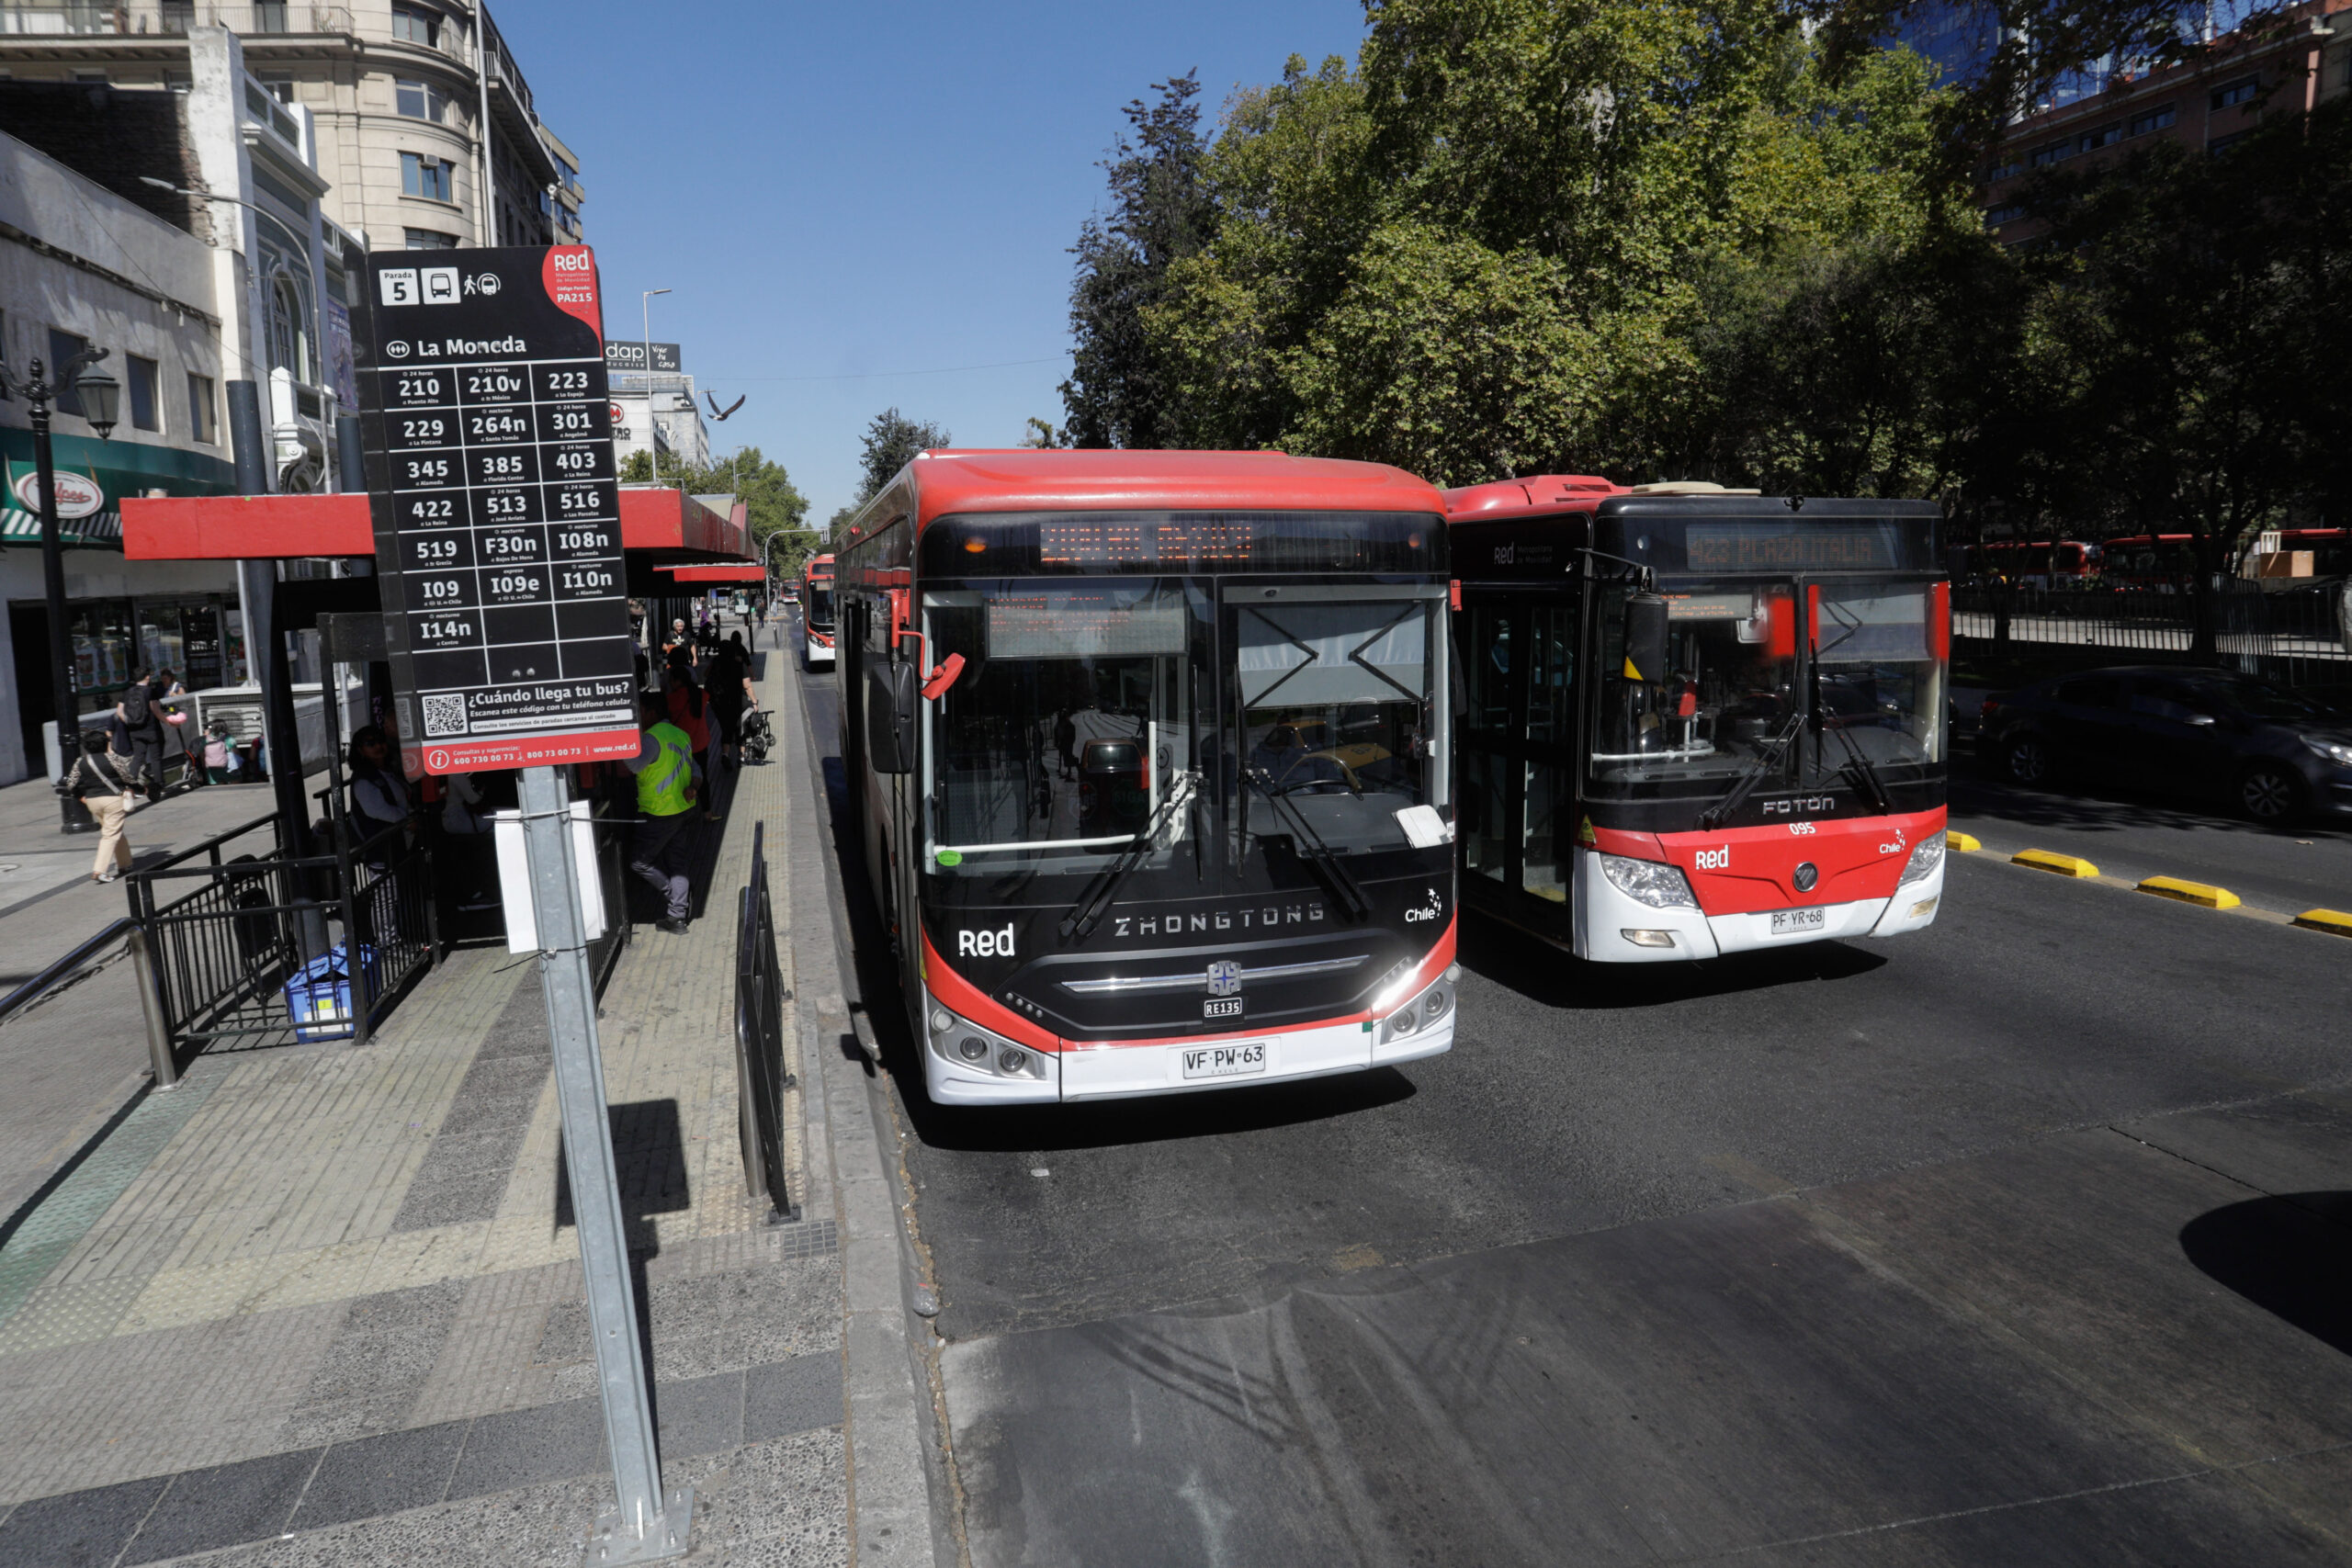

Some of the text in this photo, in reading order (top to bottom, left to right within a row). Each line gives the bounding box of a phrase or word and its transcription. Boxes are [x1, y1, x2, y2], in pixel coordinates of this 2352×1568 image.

[554, 250, 590, 271] Red
[393, 281, 406, 301] 5
[557, 292, 592, 303] PA215
[418, 335, 526, 356] La Moneda
[606, 343, 643, 361] dap
[657, 353, 666, 361] tu
[399, 378, 439, 396] 210
[469, 376, 521, 393] 210v
[548, 372, 588, 389] 223
[403, 420, 444, 437] 229
[471, 417, 526, 434] 264n
[552, 412, 593, 430] 301
[408, 460, 448, 478] 345
[482, 457, 523, 474] 385
[556, 452, 595, 469] 403
[487, 496, 526, 513] 513
[560, 491, 600, 509] 516
[413, 501, 452, 517] 422
[417, 540, 457, 558] 519
[485, 536, 537, 554] F30n
[560, 532, 608, 549] I08n
[1494, 541, 1514, 564] Red
[1690, 536, 1872, 563] 423 PLAZA ITALIA
[491, 576, 539, 593] I09e
[563, 571, 612, 588] I10n
[423, 581, 459, 598] I09
[421, 621, 471, 638] I14n
[469, 682, 628, 707] ¿Cuándo llega tu bus?
[519, 705, 545, 714] código
[573, 700, 604, 709] teléfono
[593, 742, 637, 753] www.red.cl
[1762, 796, 1835, 815] FOTON
[1789, 822, 1815, 835] 095
[1695, 843, 1729, 870] Red
[1879, 843, 1901, 854] Chile
[1114, 902, 1324, 937] ZHONGTONG
[1405, 907, 1435, 922] Chile
[959, 922, 1015, 956] Red
[1206, 1002, 1239, 1015] RE135
